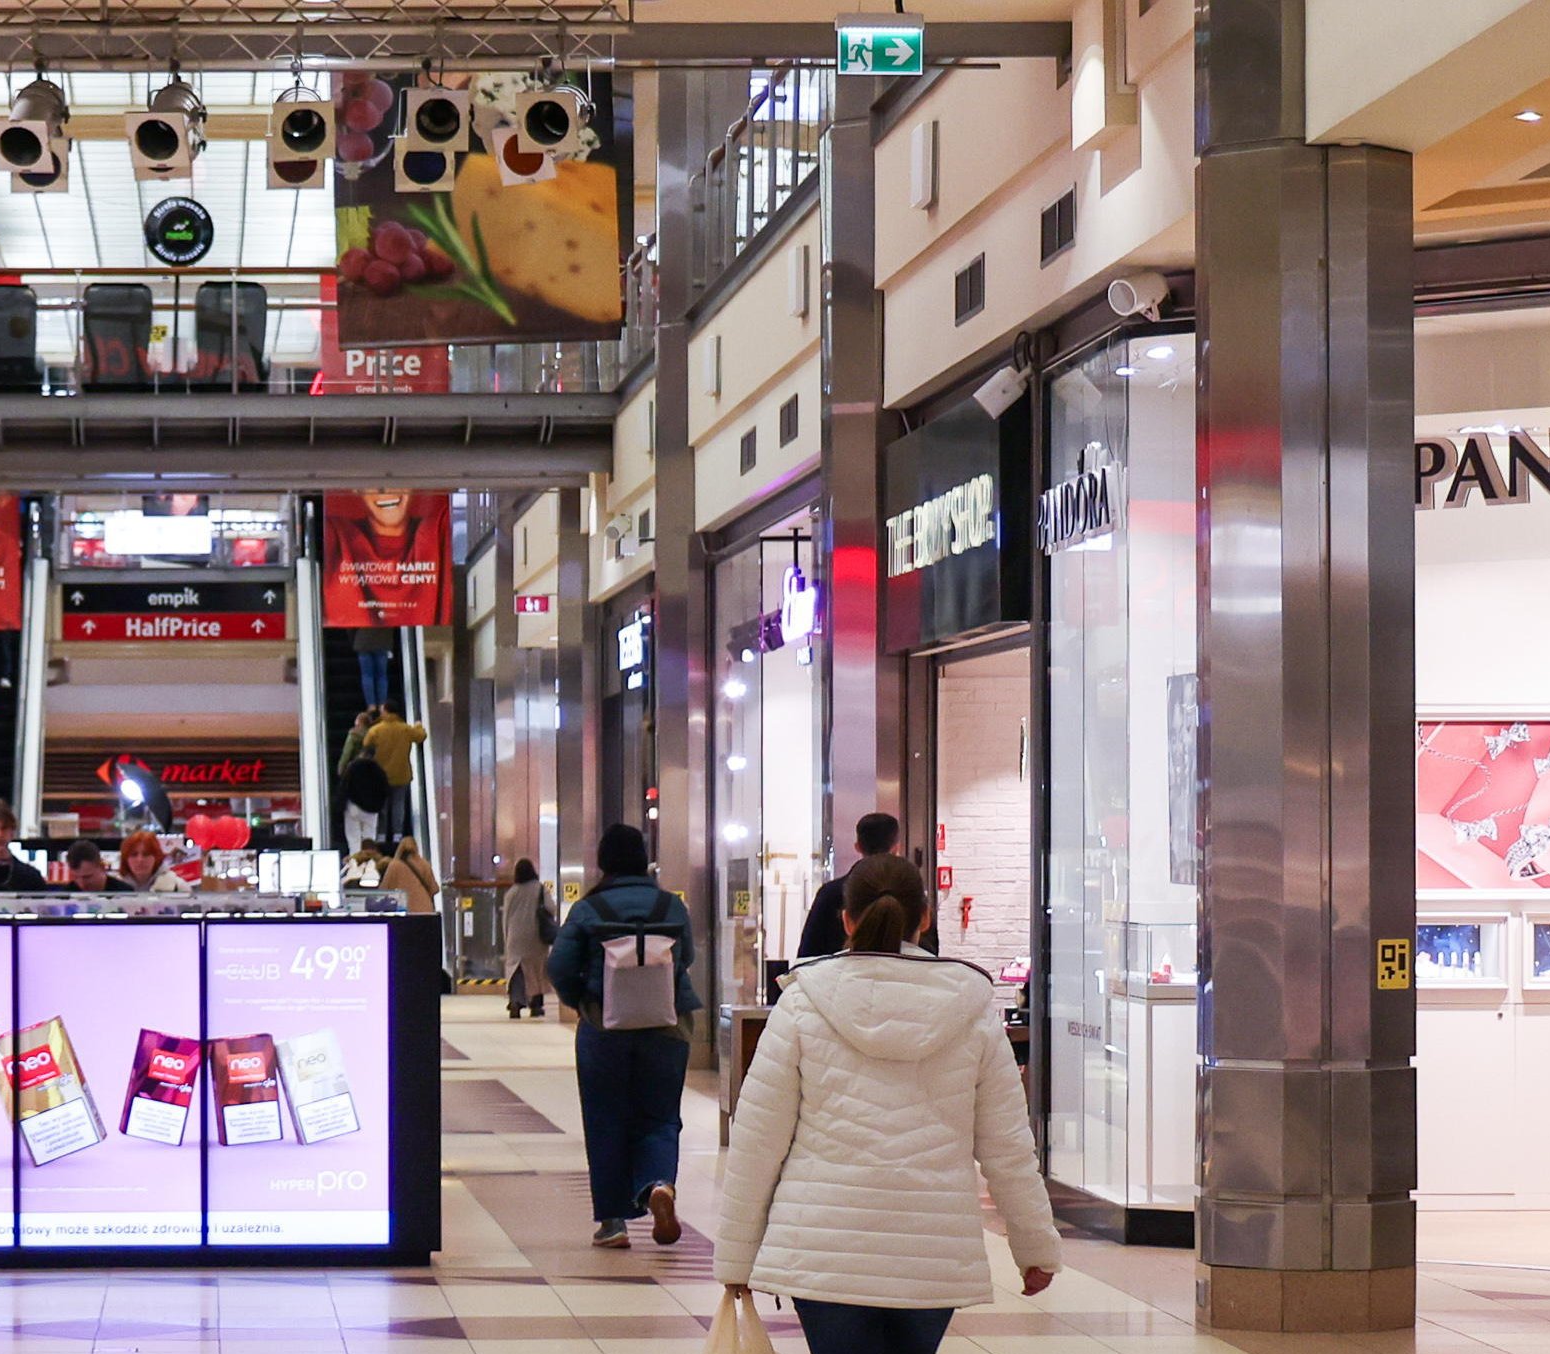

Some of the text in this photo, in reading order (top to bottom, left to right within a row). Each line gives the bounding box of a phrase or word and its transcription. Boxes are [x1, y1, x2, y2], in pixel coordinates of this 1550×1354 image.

[346, 350, 422, 376] Price
[1037, 467, 1111, 550] PANDORA
[886, 510, 913, 578] THE
[396, 562, 436, 572] MARKI
[401, 575, 437, 585] CENY!
[147, 587, 199, 608] empik
[125, 617, 221, 637] HalfPrice
[161, 759, 266, 784] market
[6, 1051, 51, 1076] neo
[152, 1054, 186, 1071] neo
[230, 1055, 261, 1071] neo
[269, 1170, 368, 1198] HYPER pro
[55, 1224, 90, 1235] może
[93, 1222, 149, 1235] szkodzić
